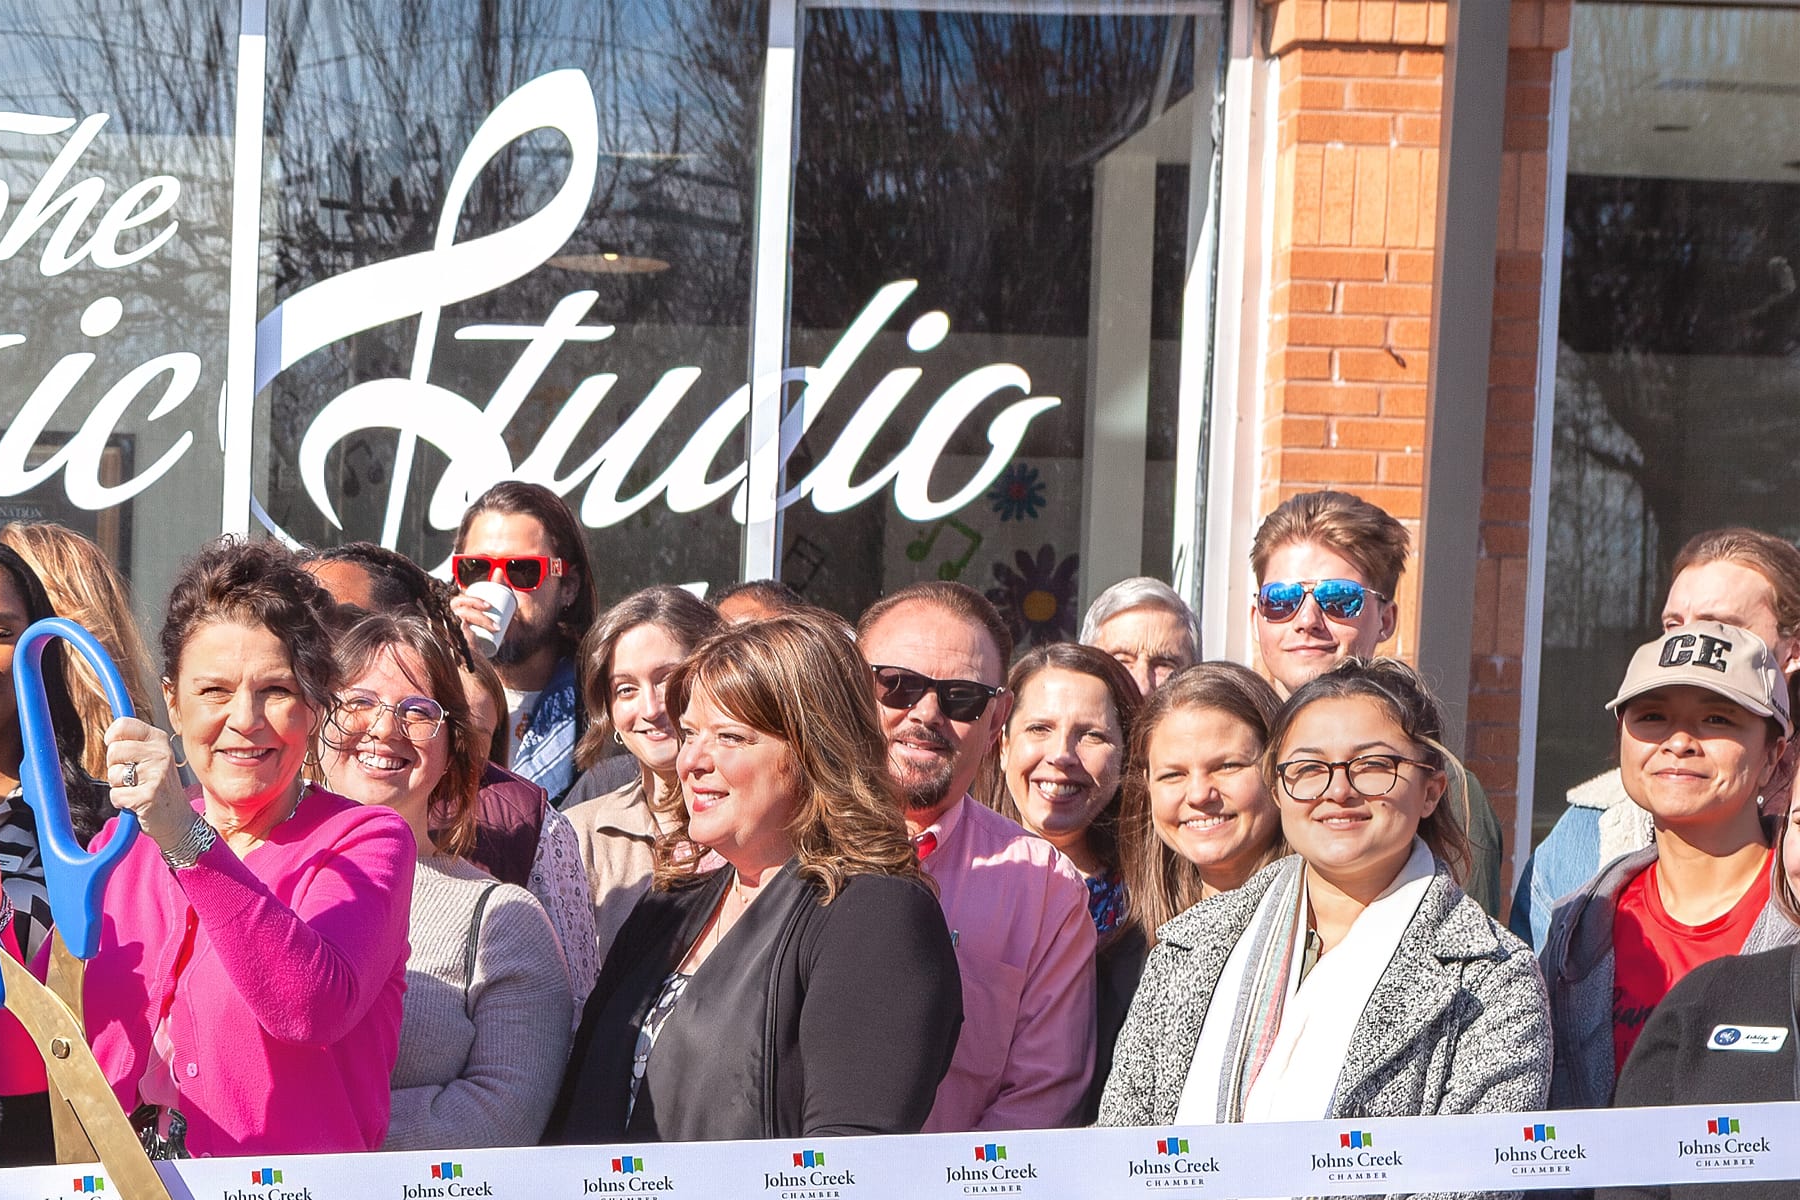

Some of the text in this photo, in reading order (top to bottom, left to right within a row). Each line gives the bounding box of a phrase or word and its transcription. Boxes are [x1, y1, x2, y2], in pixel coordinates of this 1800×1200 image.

[218, 67, 1062, 575] Studio
[1658, 633, 1733, 674] CE
[1495, 1143, 1587, 1165] Johns Creek
[1678, 1136, 1771, 1158] Johns Creek
[1129, 1157, 1220, 1177] Johns Creek
[1311, 1150, 1403, 1171] Johns Creek
[1511, 1165, 1570, 1174] CHAMBER
[1695, 1158, 1755, 1167] CHAMBER
[764, 1169, 856, 1190] Johns Creek
[946, 1163, 1038, 1183] Johns Creek
[1145, 1178, 1204, 1187] CHAMBER
[1328, 1172, 1386, 1181] CHAMBER
[403, 1181, 493, 1200] Johns Creek
[583, 1175, 674, 1195] Johns Creek
[781, 1191, 840, 1199] CHAMBER
[963, 1184, 1022, 1193] CHAMBER
